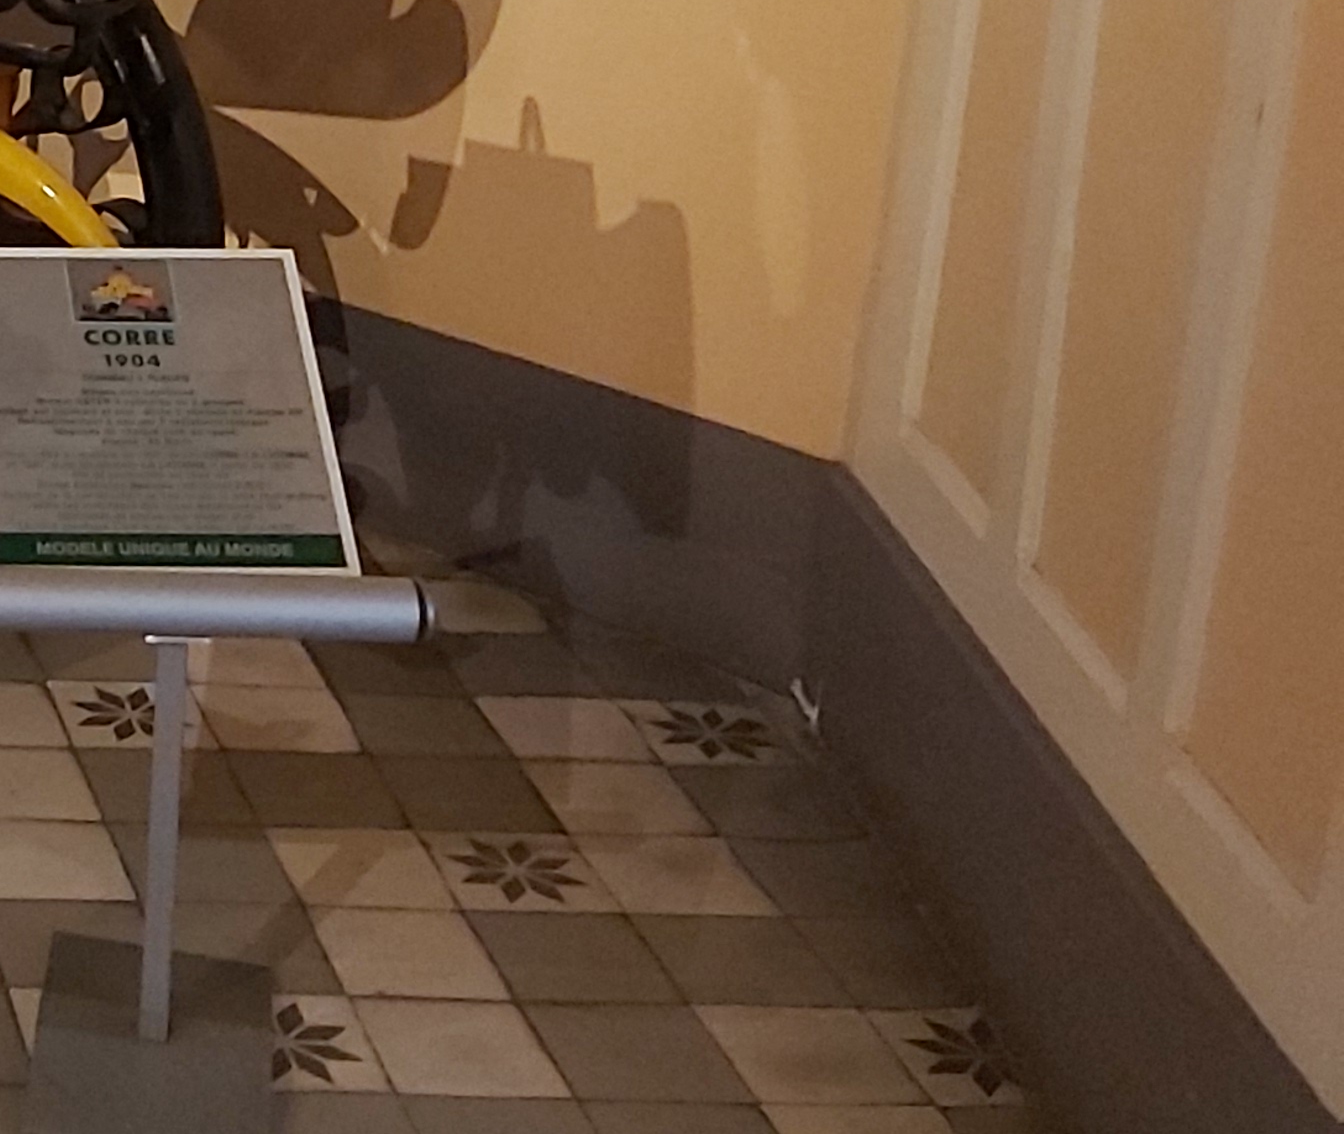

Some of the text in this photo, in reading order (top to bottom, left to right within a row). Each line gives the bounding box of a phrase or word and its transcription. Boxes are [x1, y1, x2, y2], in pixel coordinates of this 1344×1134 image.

[84, 329, 176, 347] CORRE
[104, 353, 162, 368] 1904
[119, 541, 189, 557] UNIQUE
[194, 542, 221, 557] AU
[226, 542, 294, 558] MONDE
